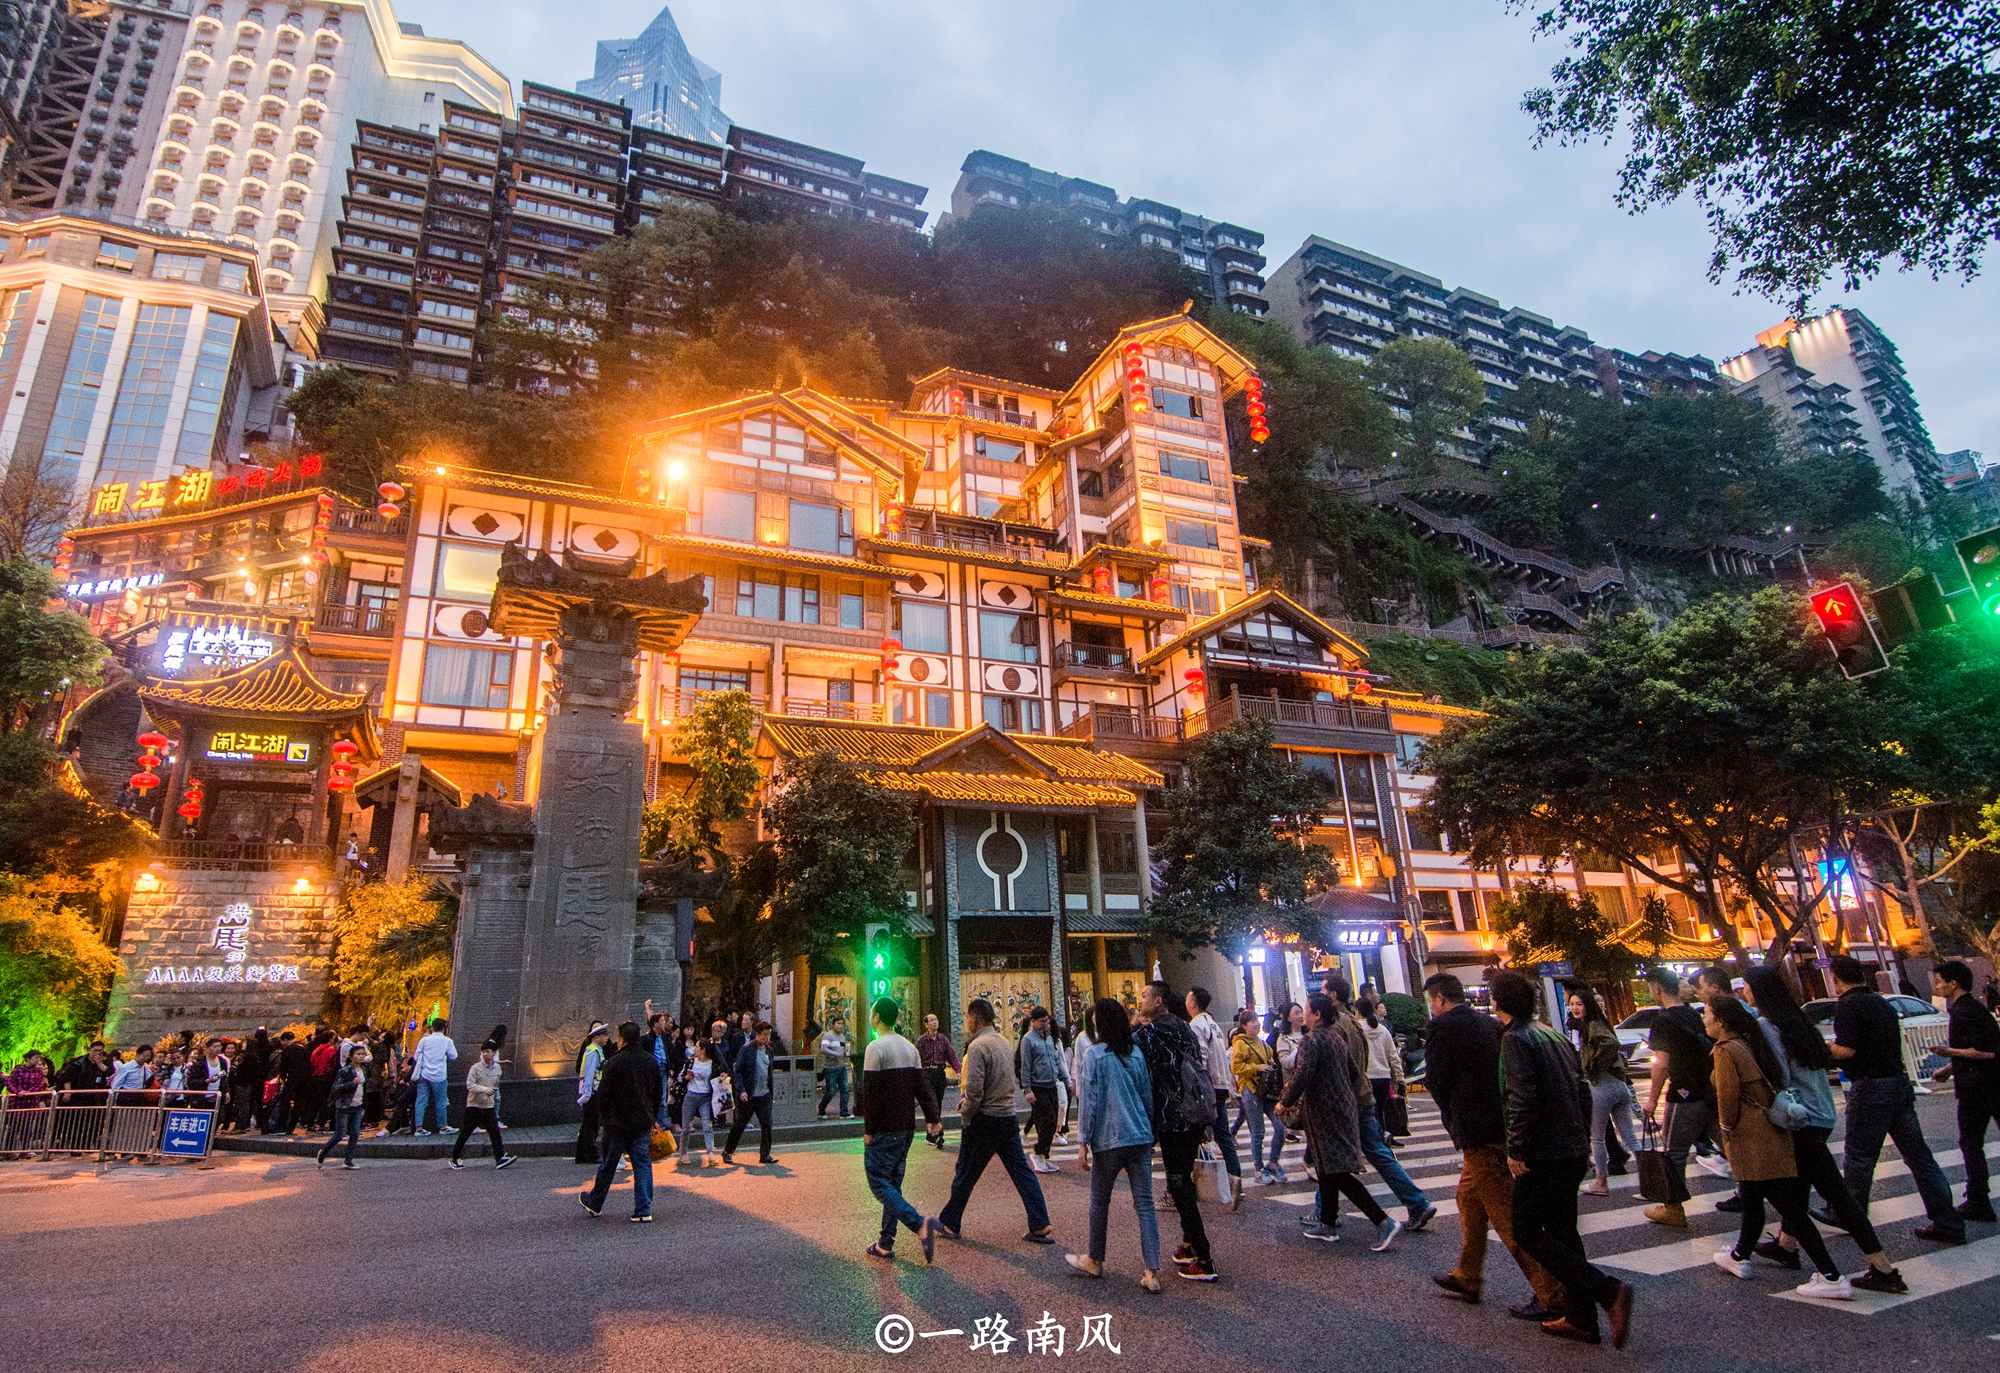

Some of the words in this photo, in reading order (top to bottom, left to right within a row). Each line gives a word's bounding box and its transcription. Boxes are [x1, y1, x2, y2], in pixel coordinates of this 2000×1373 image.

[93, 470, 214, 517] 闹江湖
[211, 732, 288, 753] 闹江湖
[146, 964, 301, 984] AAAA级旅游景区
[873, 980, 887, 995] 19
[169, 1116, 208, 1134] 车库进口
